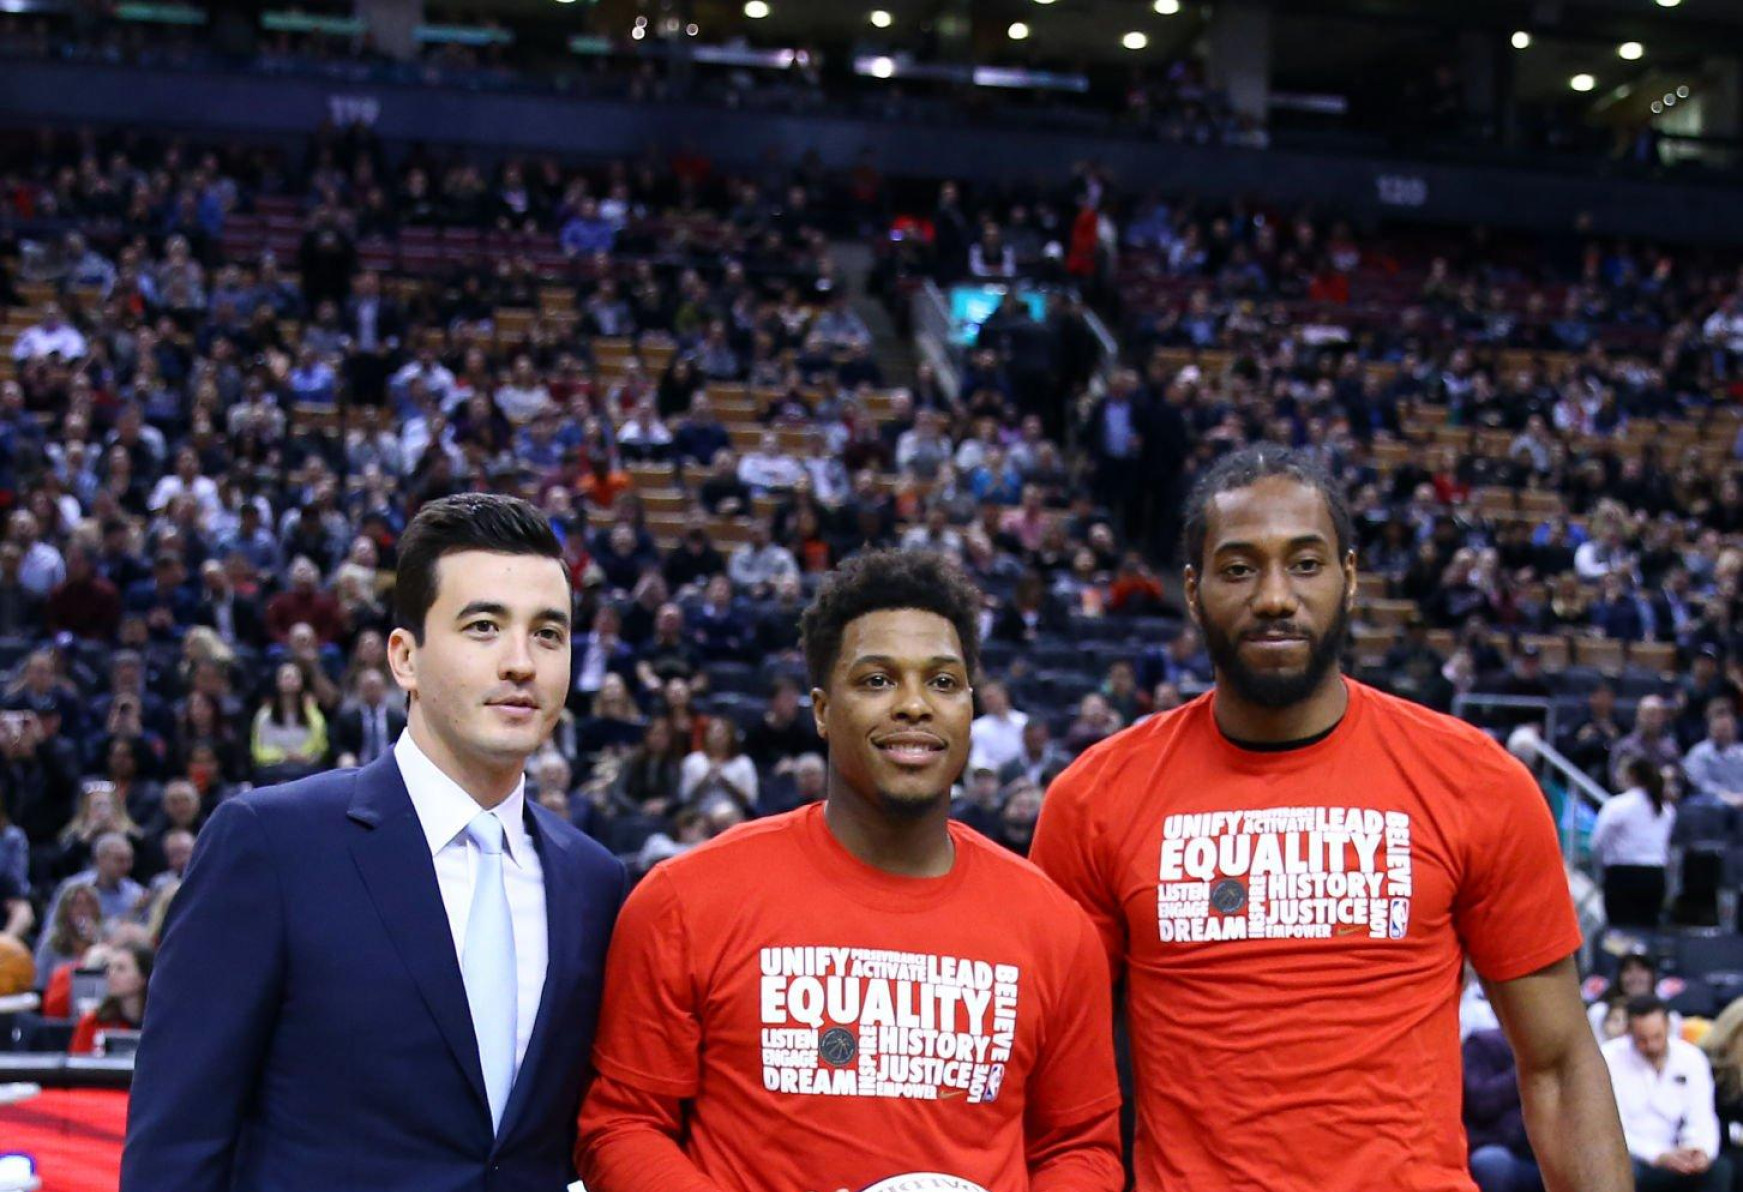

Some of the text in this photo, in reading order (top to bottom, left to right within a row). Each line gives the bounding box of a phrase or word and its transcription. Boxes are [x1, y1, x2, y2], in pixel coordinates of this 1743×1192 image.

[1163, 811, 1244, 840] UNIFY
[1243, 816, 1315, 834] ACTIVATE
[1315, 807, 1385, 835] LEAD
[1159, 831, 1383, 882] EQUALITY
[1385, 810, 1412, 897] BELIEVE
[1158, 882, 1210, 901] LISTEN
[1268, 871, 1384, 900] HISTORY
[1158, 900, 1209, 919] ENGAGE
[1265, 898, 1368, 925] JUSTICE
[1369, 898, 1388, 939] LOVE
[1159, 917, 1247, 942] DREAM
[1265, 924, 1332, 939] EMPOWER
[760, 947, 850, 977] UNIFY
[851, 960, 927, 982] ACTIVATE
[928, 955, 993, 990] LEAD
[760, 975, 992, 1035] EQUALITY
[991, 964, 1019, 1062] BELIEVE
[761, 1028, 819, 1049] LISTEN
[878, 1026, 990, 1063] HISTORY
[762, 1049, 818, 1069] ENGAGE
[858, 1025, 877, 1096] INSPIRE
[876, 1055, 973, 1089] JUSTICE
[763, 1067, 858, 1095] DREAM
[876, 1082, 938, 1100] EMPOWER
[967, 1063, 990, 1104] LOVE
